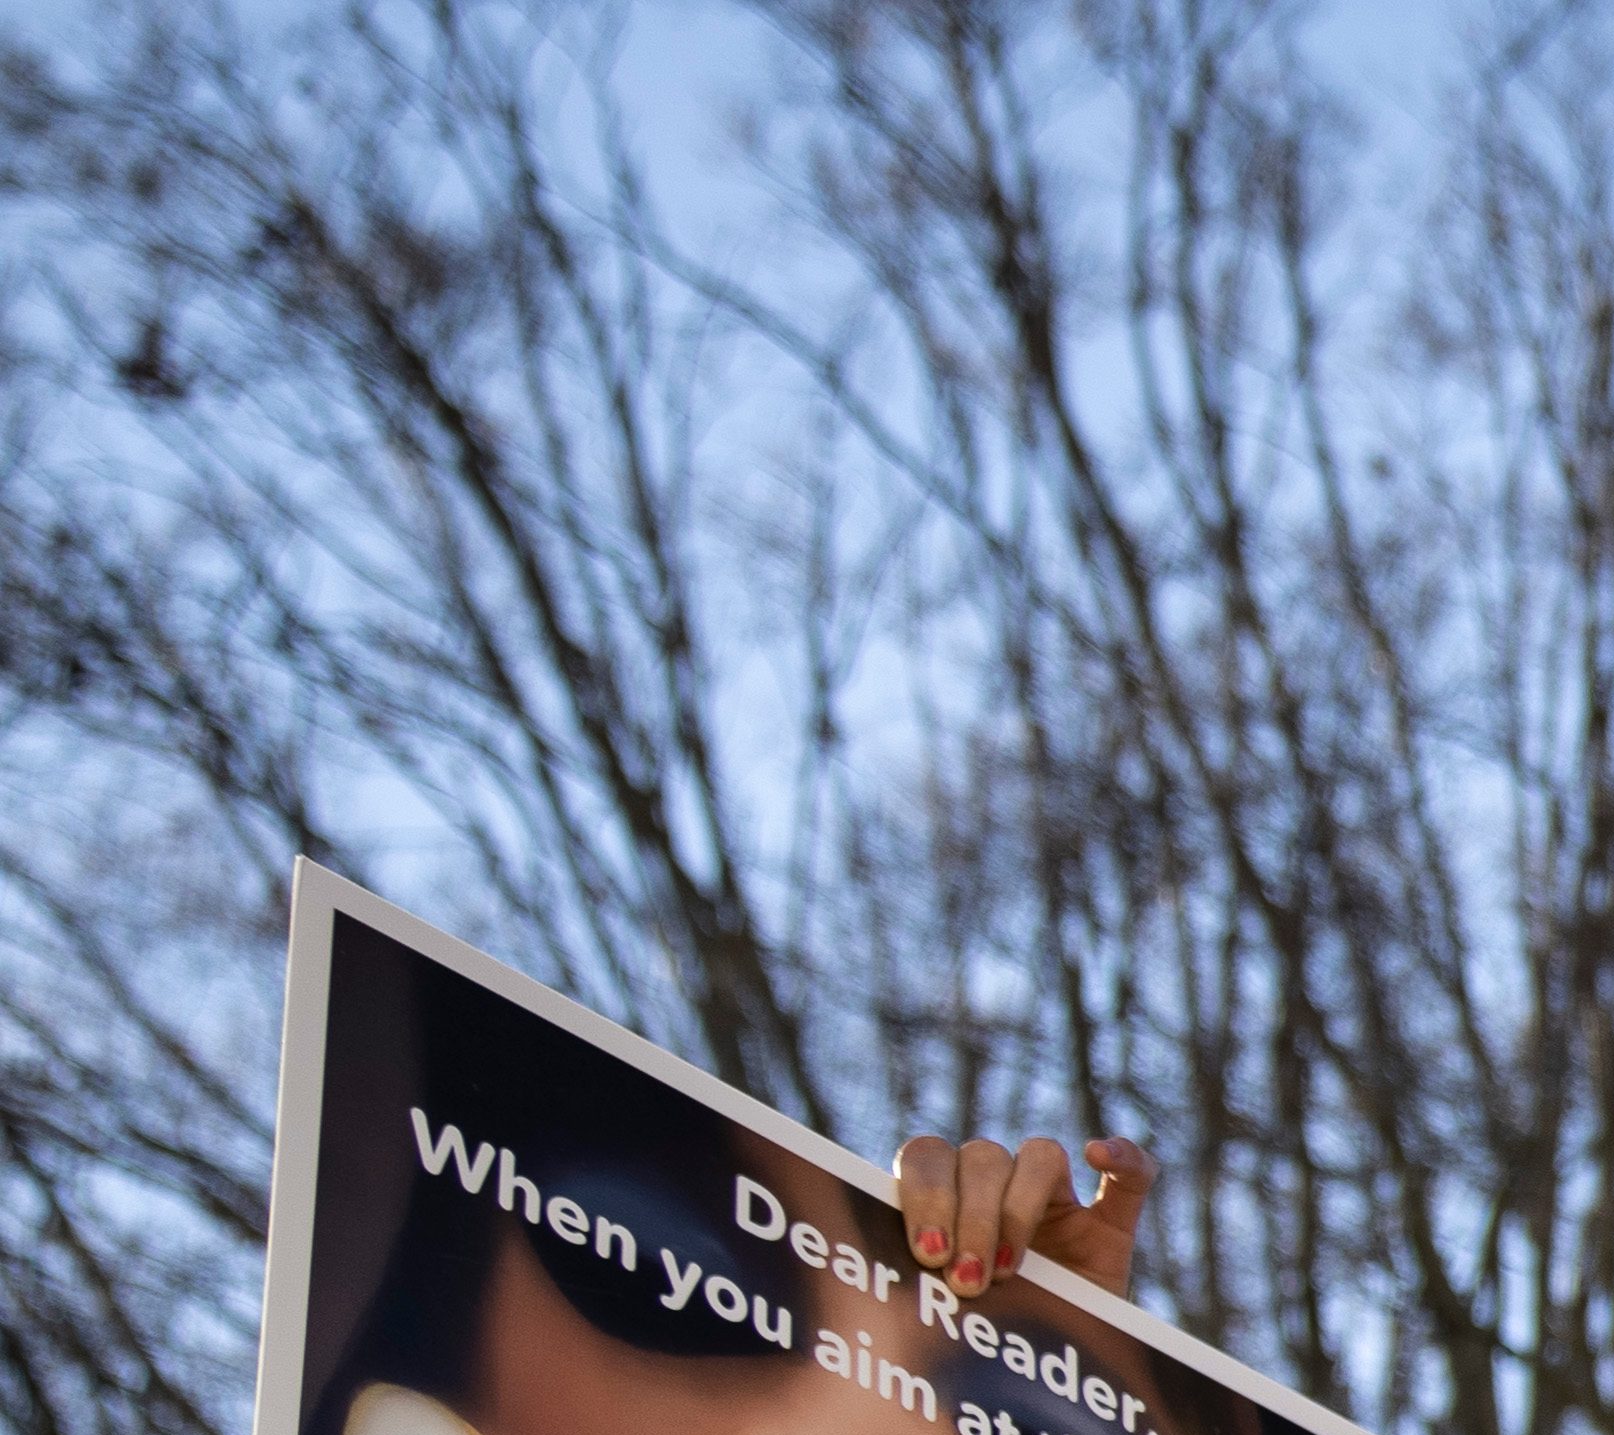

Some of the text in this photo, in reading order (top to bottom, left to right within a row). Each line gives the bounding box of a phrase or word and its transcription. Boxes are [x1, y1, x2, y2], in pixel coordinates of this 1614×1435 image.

[409, 1106, 638, 1273] When
[659, 1247, 793, 1350] you
[813, 1327, 938, 1424] aim
[734, 1173, 900, 1303] Dear
